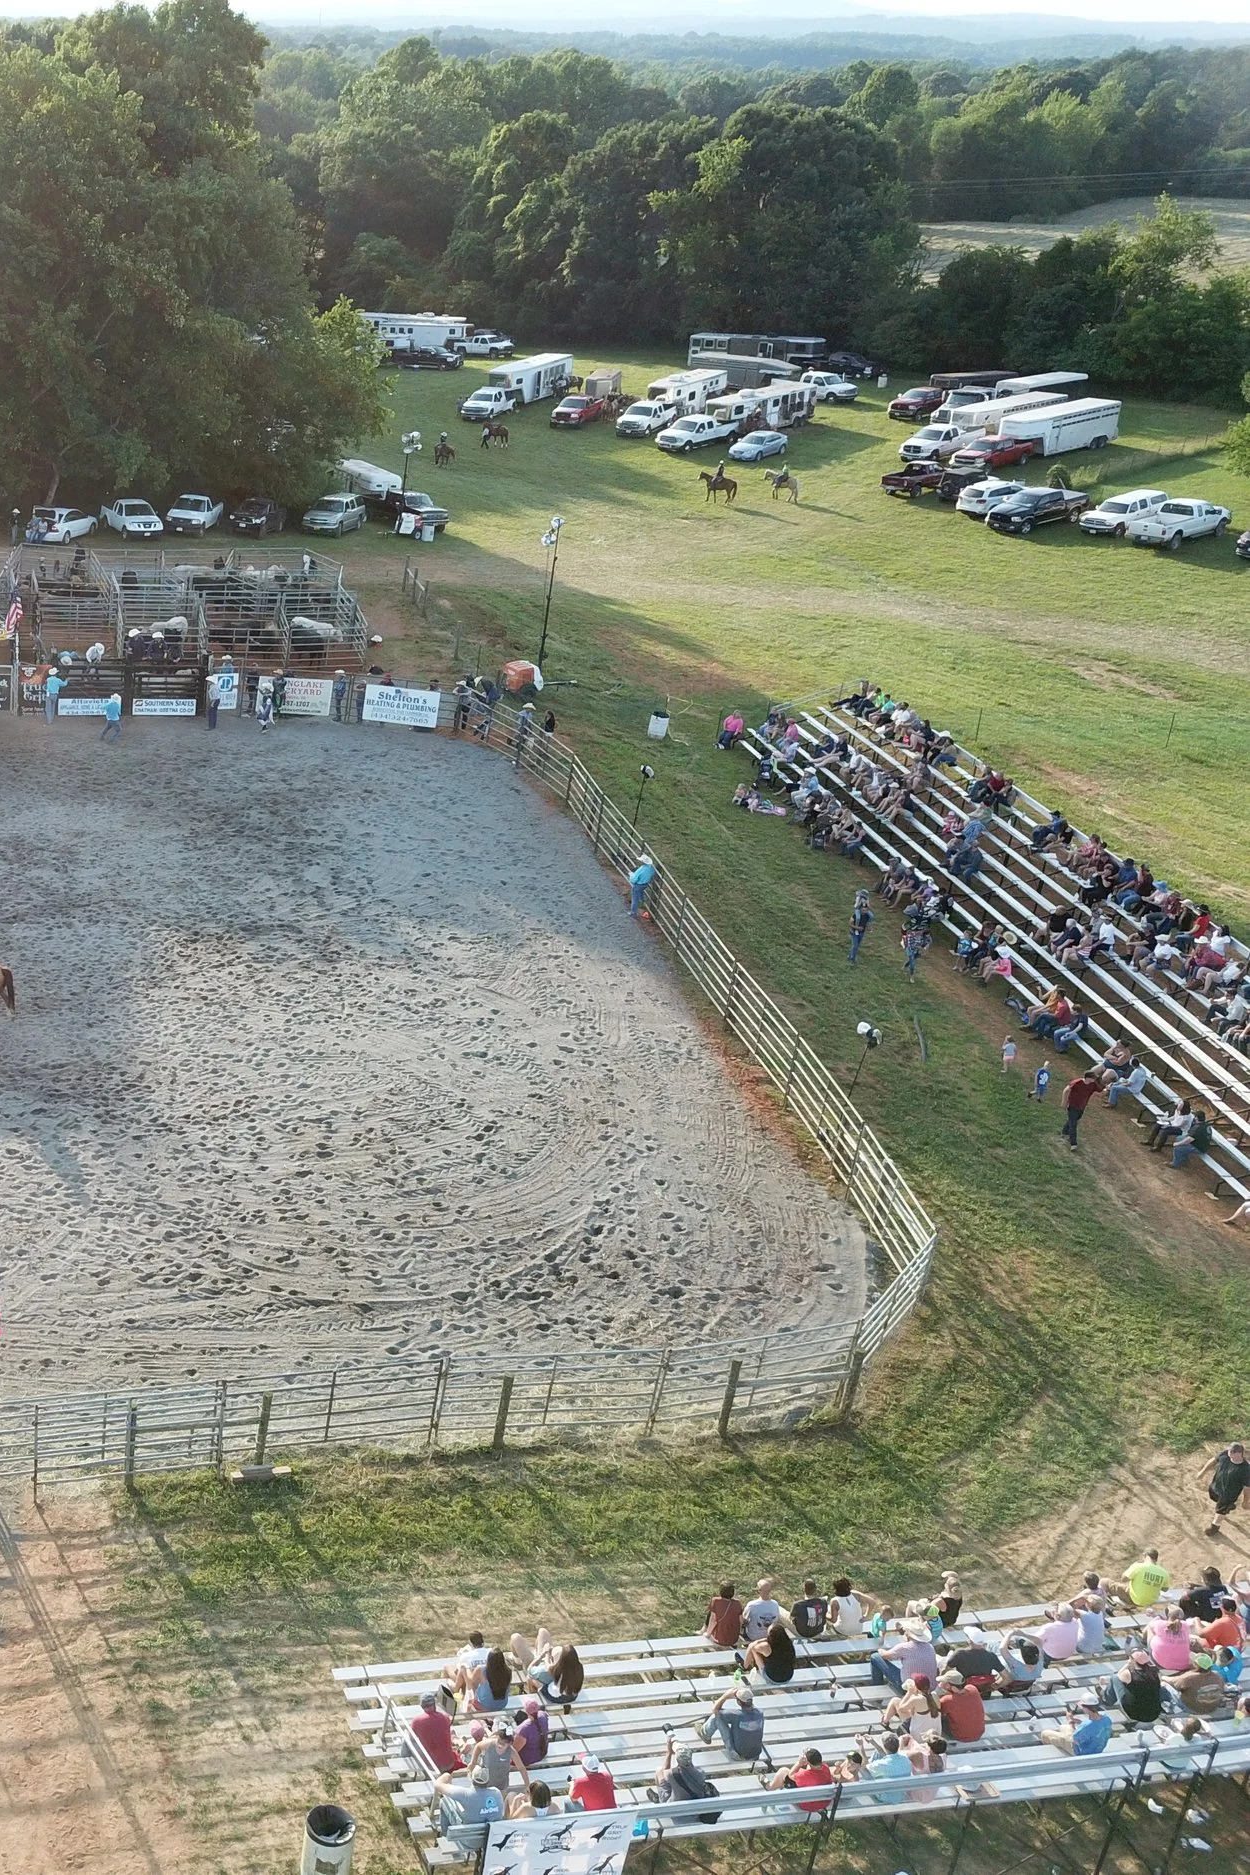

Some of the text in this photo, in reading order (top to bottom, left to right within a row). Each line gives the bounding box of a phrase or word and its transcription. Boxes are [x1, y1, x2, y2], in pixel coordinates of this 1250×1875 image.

[378, 692, 428, 704] Shelton's
[367, 699, 395, 708] HEATING
[402, 704, 437, 714] PLUMBING
[1144, 1572, 1164, 1584] HURT
